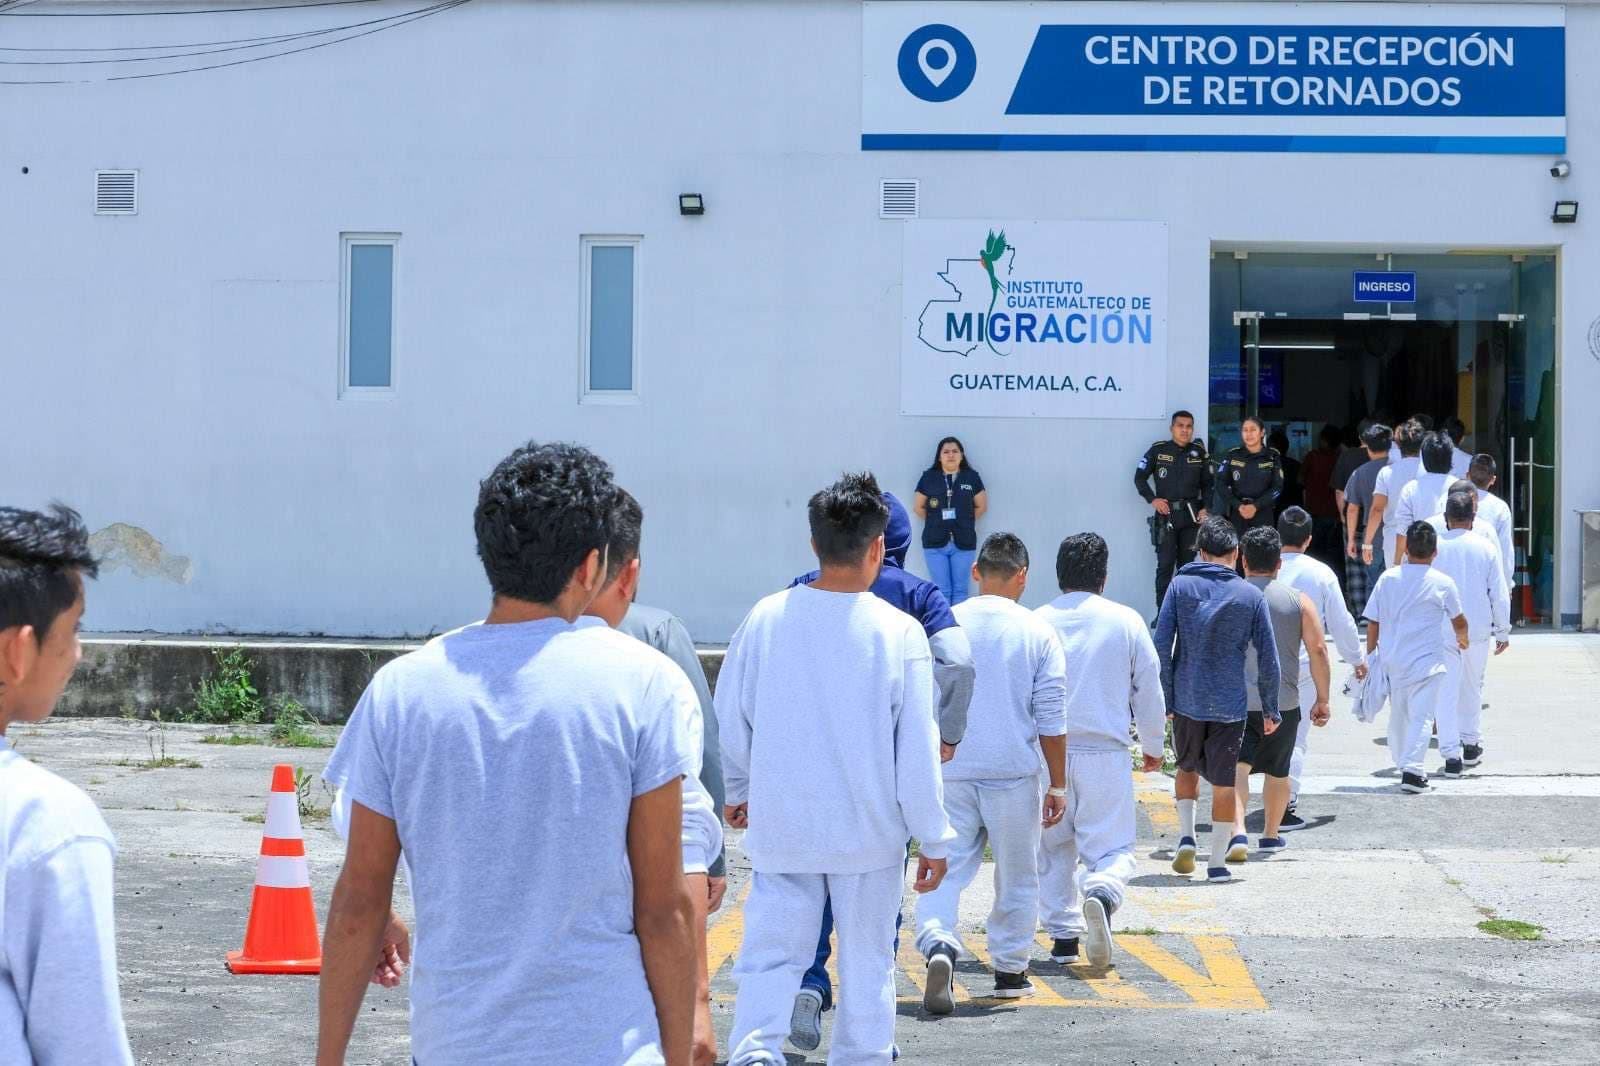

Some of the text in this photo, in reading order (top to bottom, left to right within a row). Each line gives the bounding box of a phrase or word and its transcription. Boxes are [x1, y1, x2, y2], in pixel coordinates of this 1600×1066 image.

[1085, 32, 1514, 66] CENTRO DE RECEPCIÓN
[1143, 76, 1462, 107] DE RETORNADOS
[1007, 281, 1083, 294] INSTITUTO
[1359, 281, 1411, 292] INGRESO
[1007, 296, 1151, 310] GUATEMALTECO DE
[946, 310, 1152, 344] MIGRACIÓN
[950, 374, 1122, 393] GUATEMALA, C.A.
